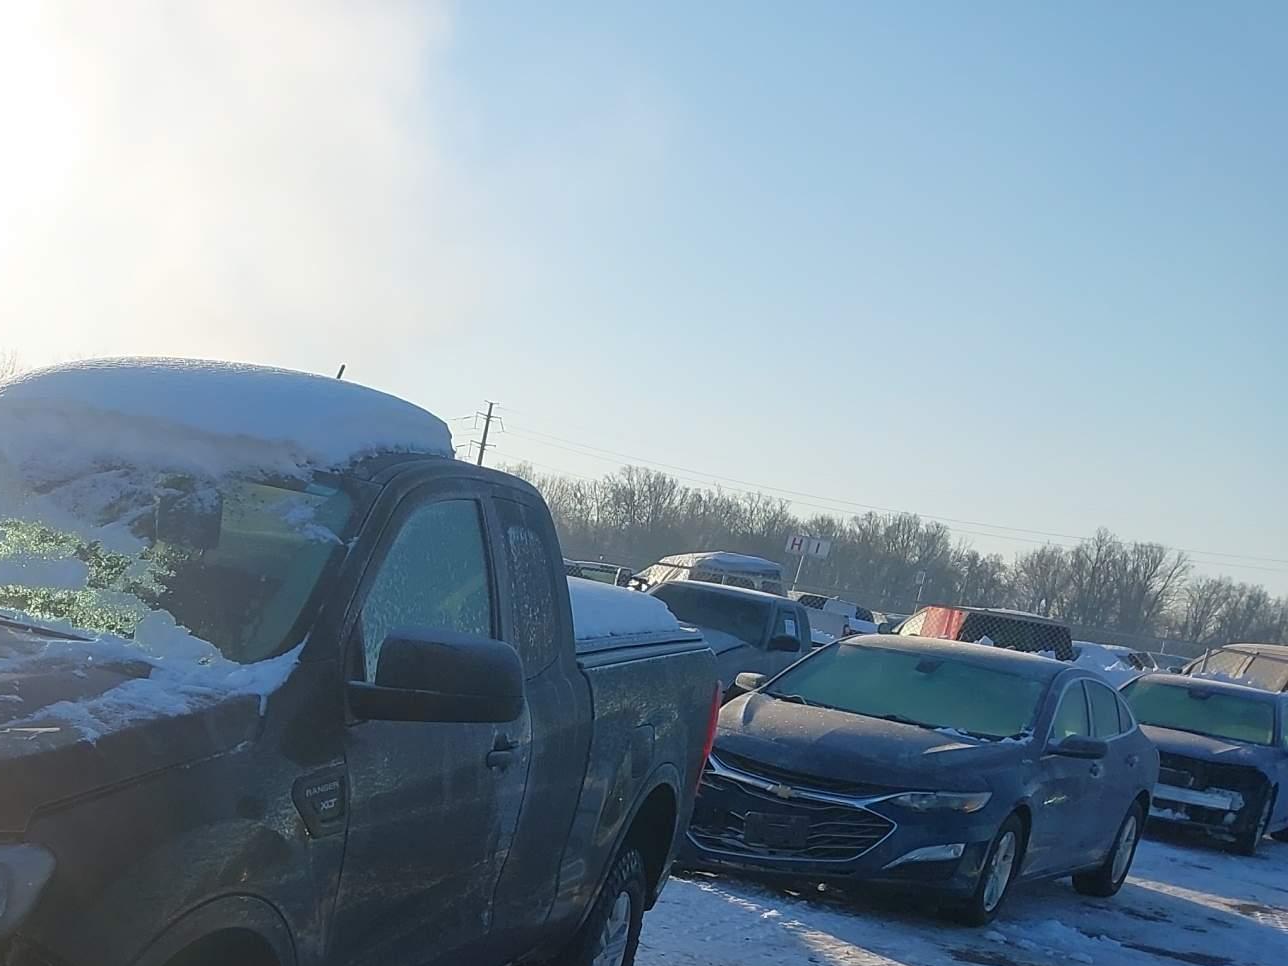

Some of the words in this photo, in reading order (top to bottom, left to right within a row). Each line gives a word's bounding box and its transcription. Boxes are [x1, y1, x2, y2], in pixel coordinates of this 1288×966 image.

[791, 537, 803, 551] H
[305, 781, 339, 798] RANGER
[320, 798, 338, 811] XLT
